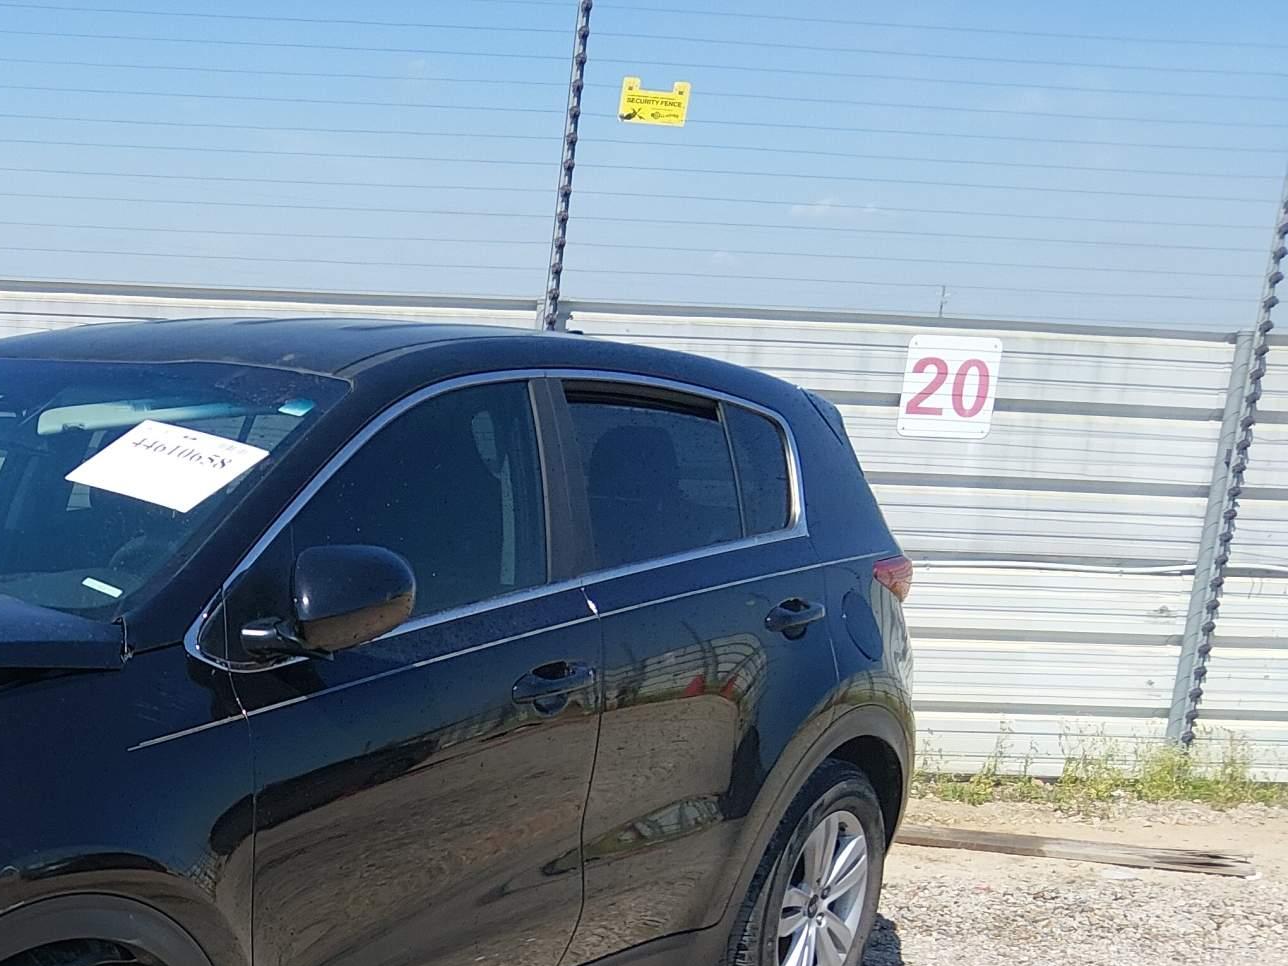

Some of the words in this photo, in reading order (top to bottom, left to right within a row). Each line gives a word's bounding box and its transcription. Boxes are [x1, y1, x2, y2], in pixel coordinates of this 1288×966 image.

[626, 97, 659, 106] SECURITY
[659, 100, 682, 108] FENCE
[905, 356, 990, 418] 20
[132, 437, 232, 469] 44610658
